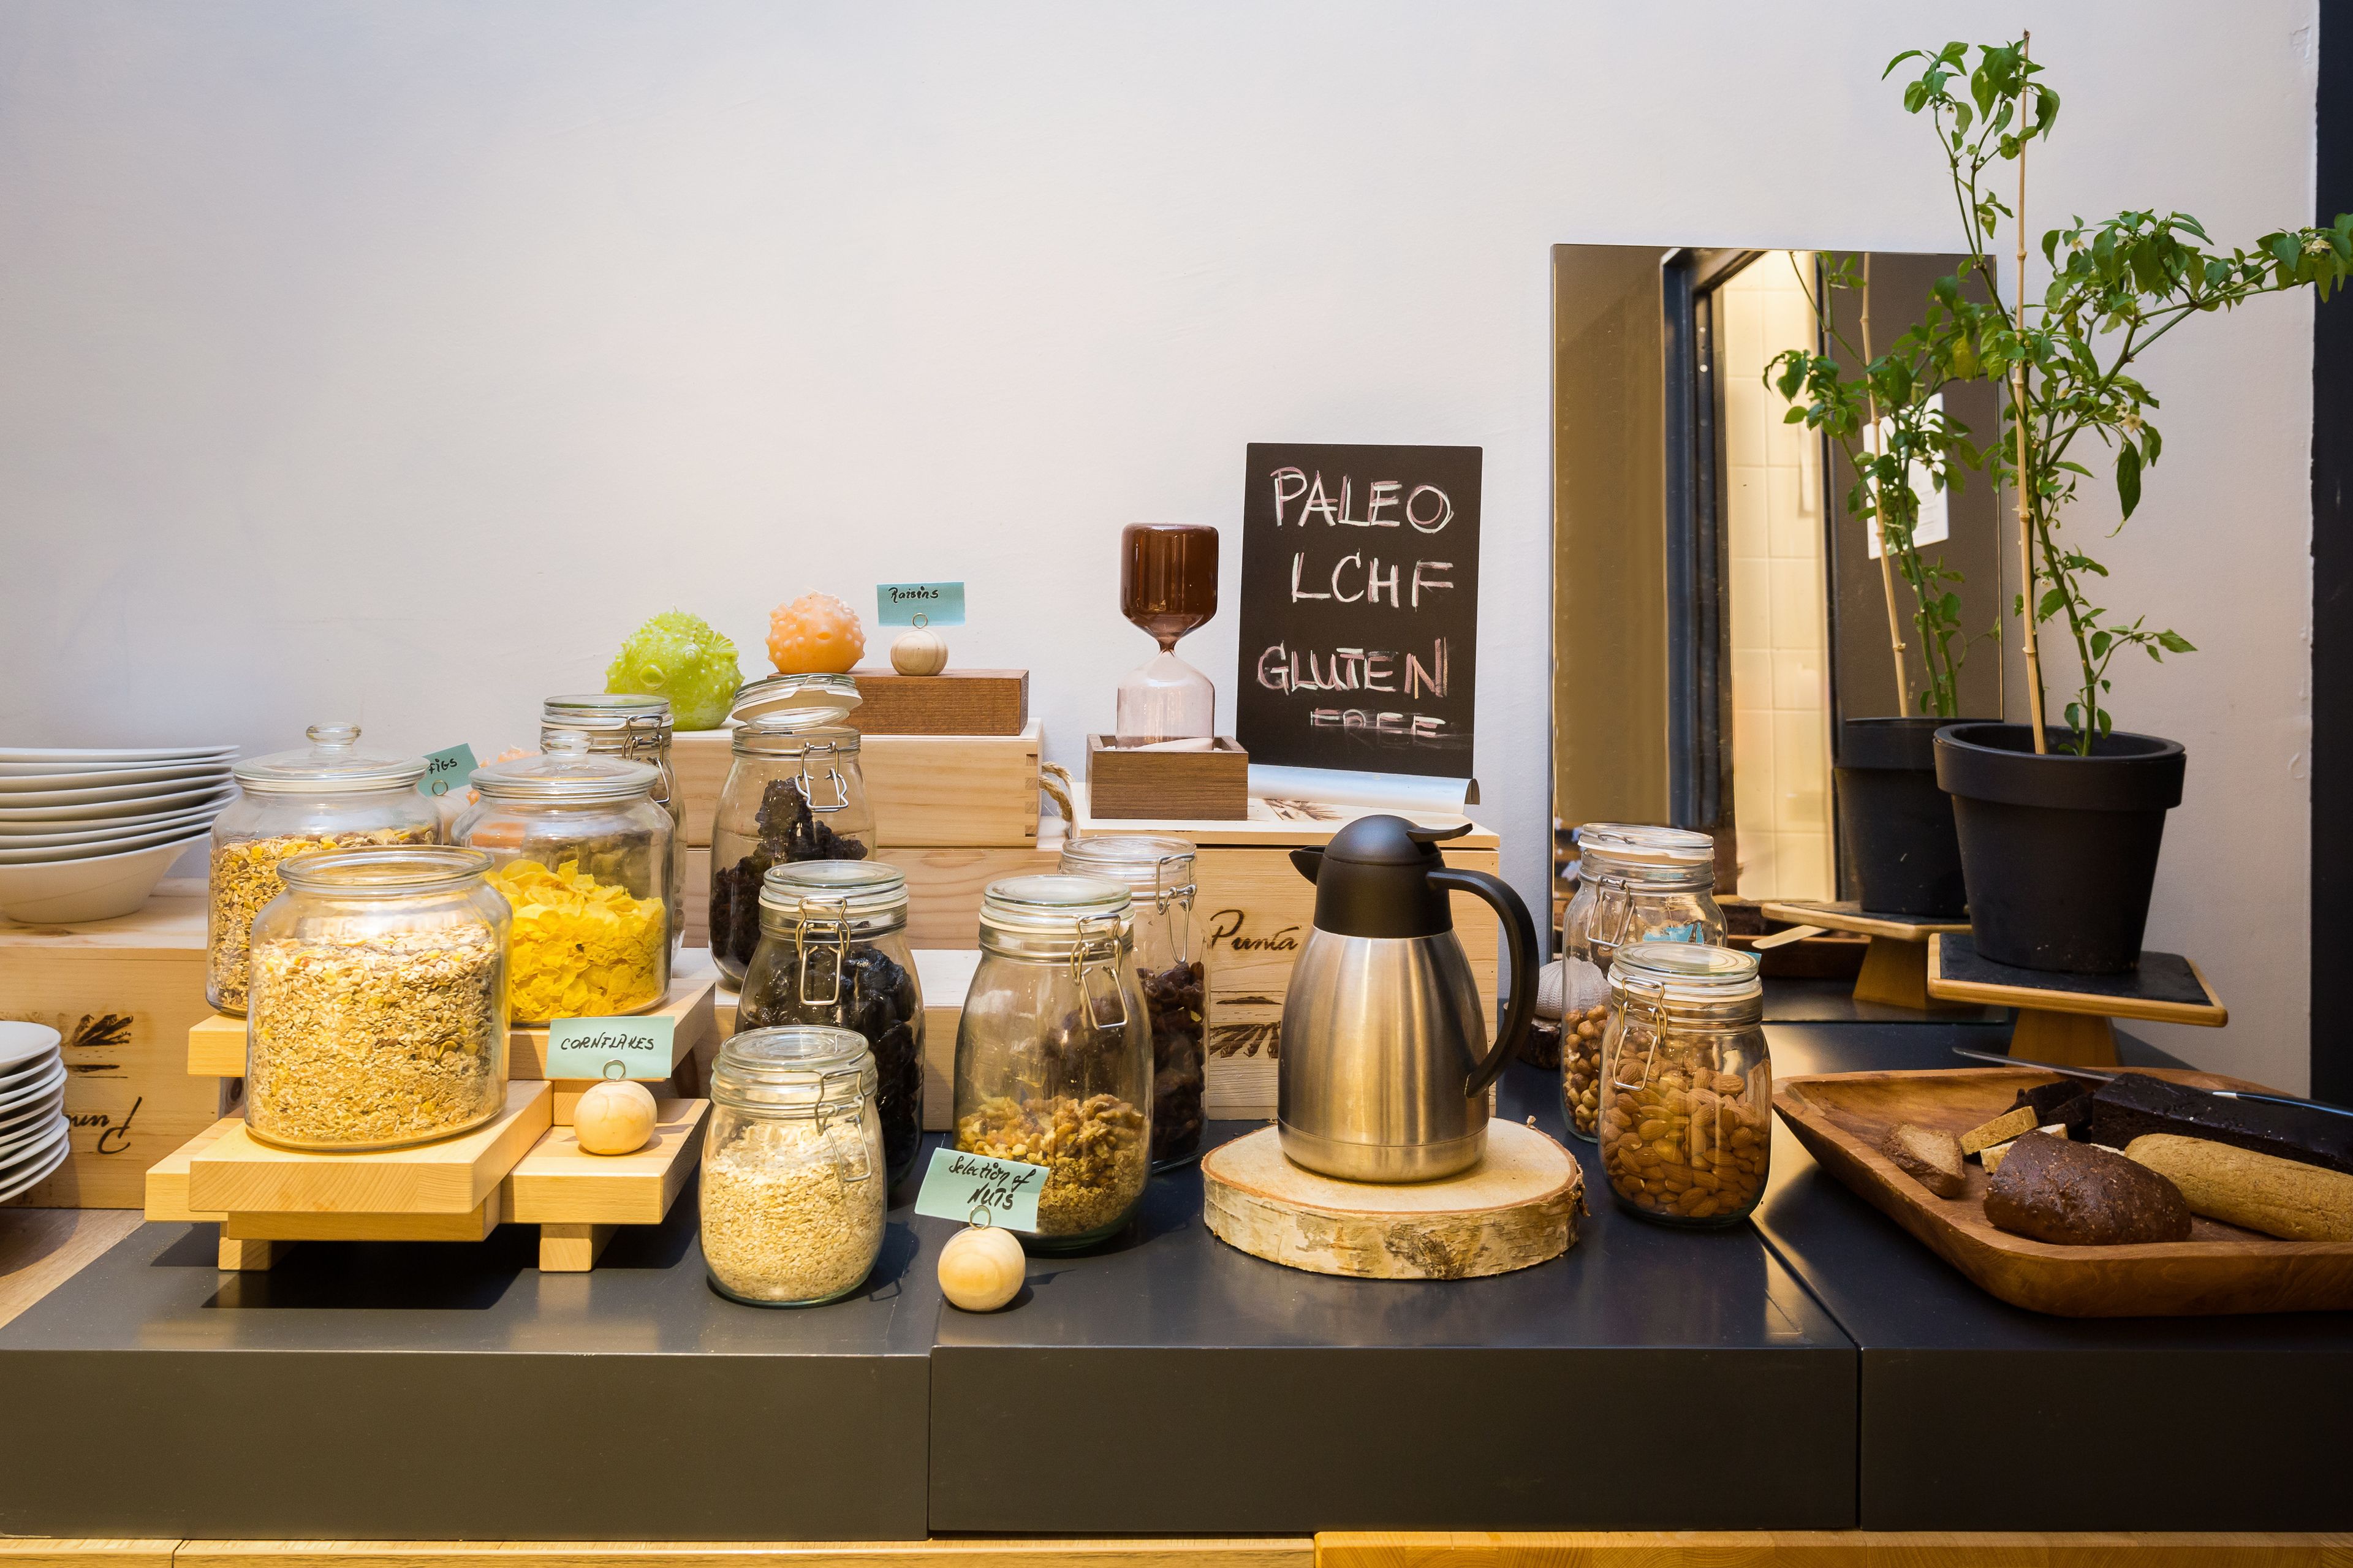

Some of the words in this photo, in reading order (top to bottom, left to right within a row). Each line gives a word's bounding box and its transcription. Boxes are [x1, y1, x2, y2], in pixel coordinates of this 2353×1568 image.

[1270, 466, 1454, 533] PALEO
[889, 586, 939, 604] Raisins
[1291, 549, 1453, 612] LCHF
[1256, 637, 1448, 699] GLUTEN
[561, 1032, 654, 1050] CORNFLAKES
[949, 1156, 1011, 1187] Selection
[1012, 1168, 1037, 1192] of
[967, 1183, 1014, 1210] NUTS
